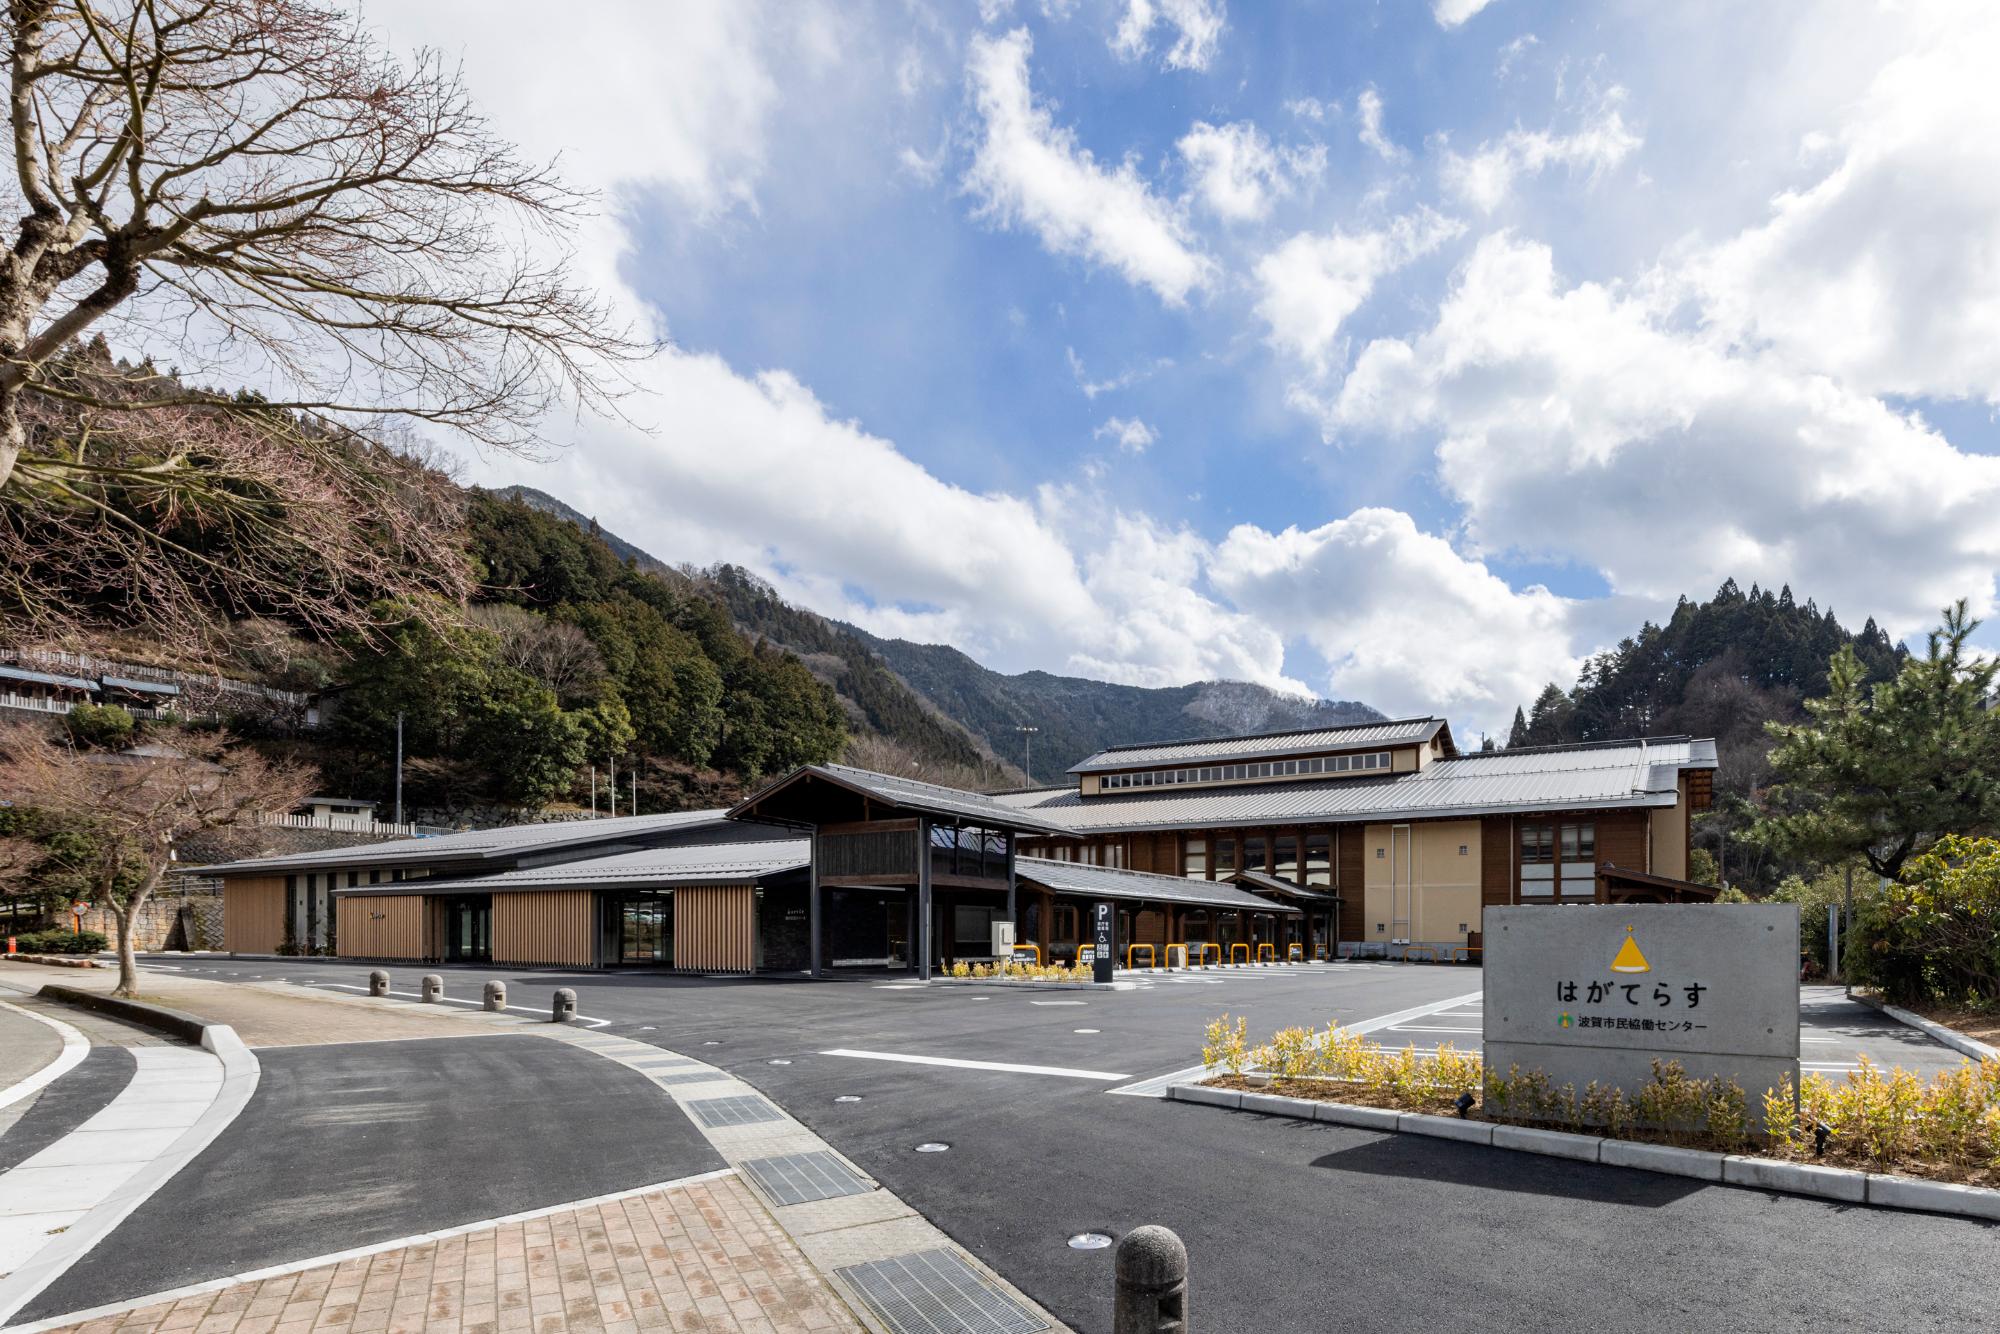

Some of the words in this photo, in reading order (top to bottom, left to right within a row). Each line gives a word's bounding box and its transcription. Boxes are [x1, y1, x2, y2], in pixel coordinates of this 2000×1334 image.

[1099, 905, 1108, 920] P
[1557, 980, 1707, 1008] はがてらす
[1578, 1016, 1707, 1032] 波賀市民協働センター
